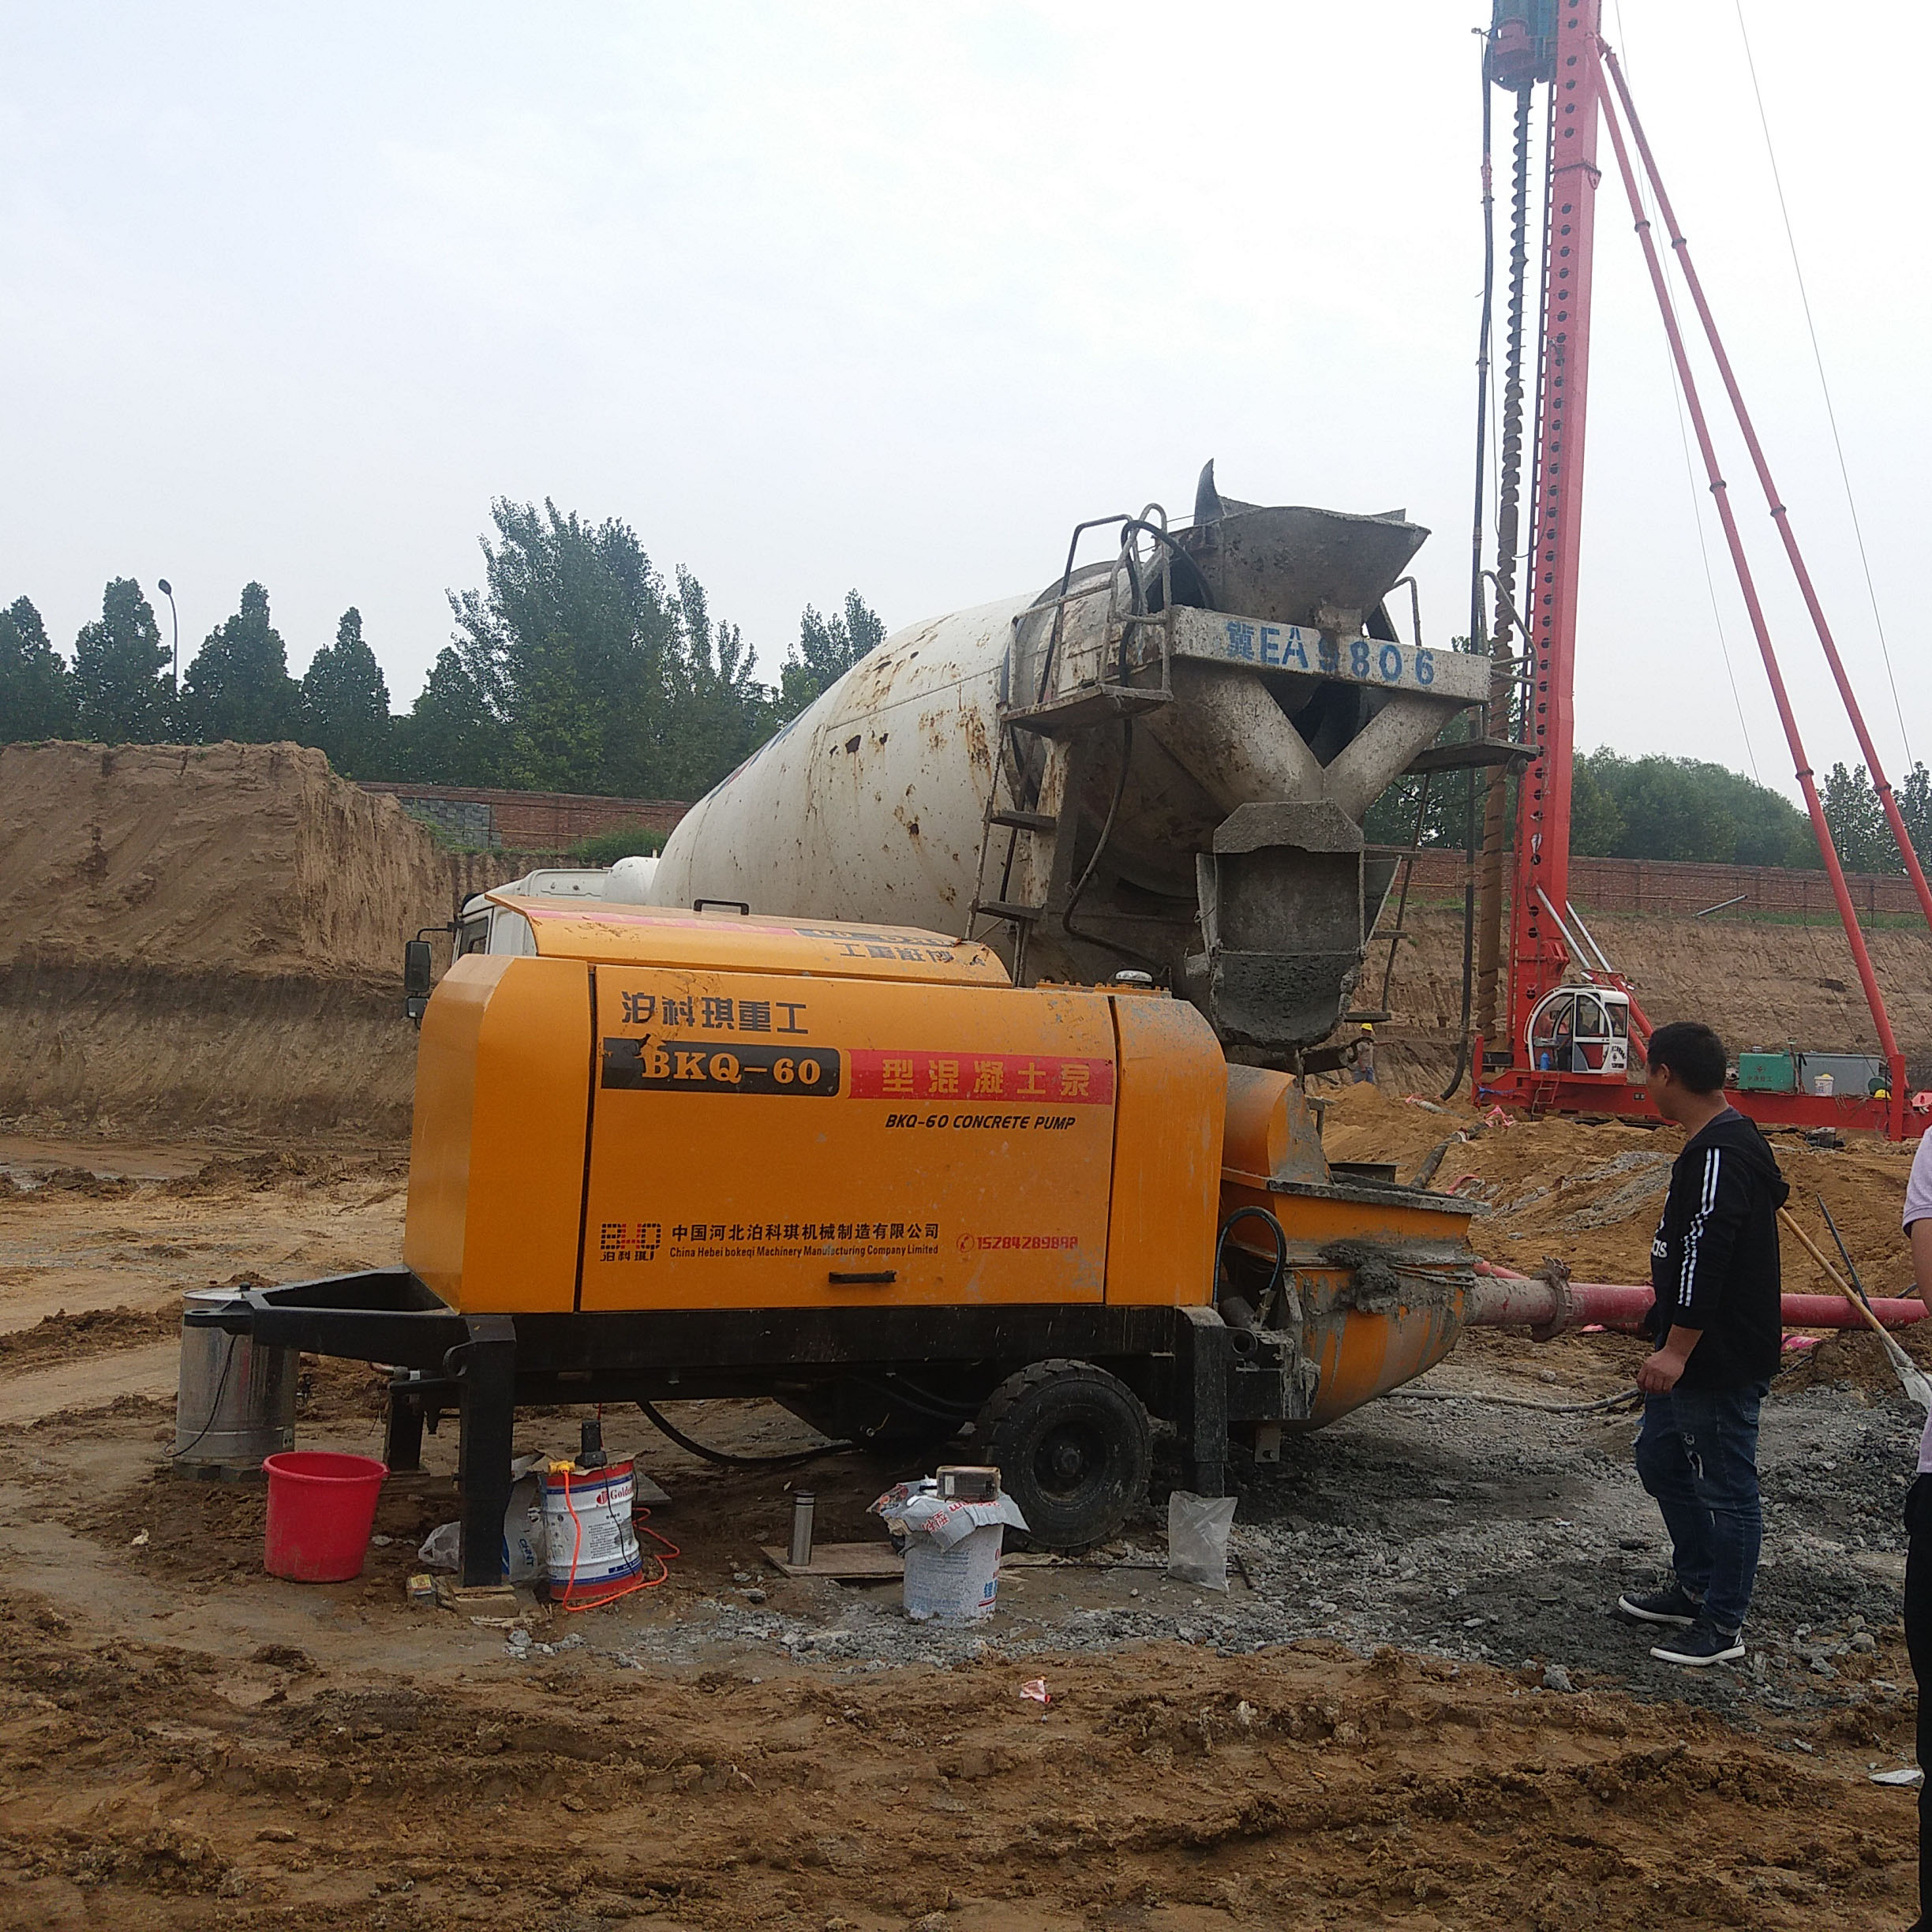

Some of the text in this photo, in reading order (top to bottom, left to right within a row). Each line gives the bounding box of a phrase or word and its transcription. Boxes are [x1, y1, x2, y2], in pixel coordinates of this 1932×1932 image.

[622, 991, 808, 1034] 泊科琪重工
[641, 1047, 821, 1084] BKQ-60
[882, 1058, 1089, 1096] 型混凝土泵
[885, 1114, 1076, 1129] BKQ-60 CONCRETE PUMP
[672, 1223, 939, 1241] 中国河北泊科琪机械制造有限公司
[669, 1244, 938, 1258] China Hebei bokeqi Machinery Manufacturing Company Limited
